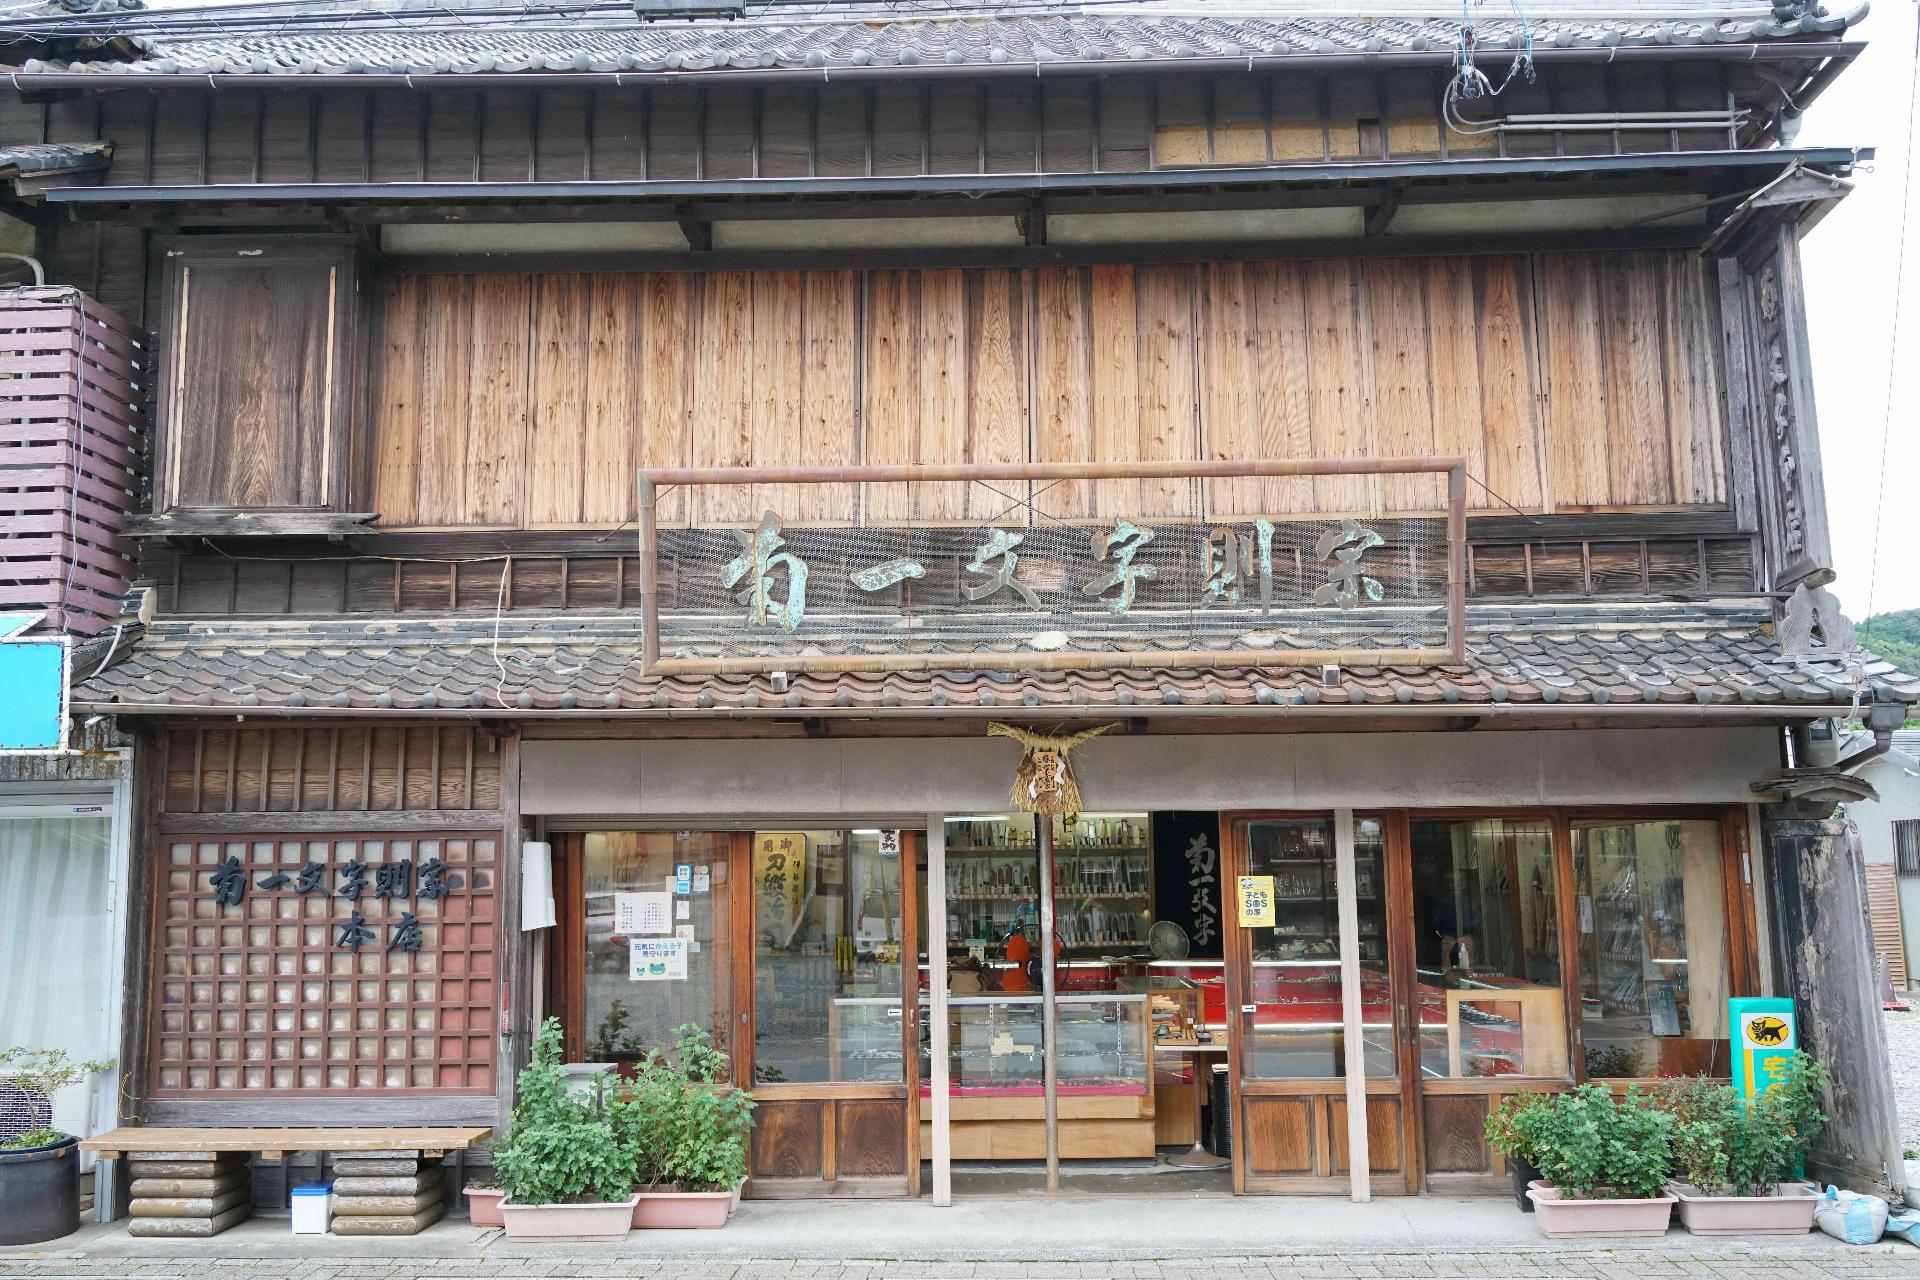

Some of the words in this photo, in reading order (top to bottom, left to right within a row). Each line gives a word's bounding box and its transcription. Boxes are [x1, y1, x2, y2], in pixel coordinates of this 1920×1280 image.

[720, 510, 1386, 633] 菊一文字則宗
[336, 910, 423, 954] 本店
[1185, 833, 1217, 946] 菊一文字
